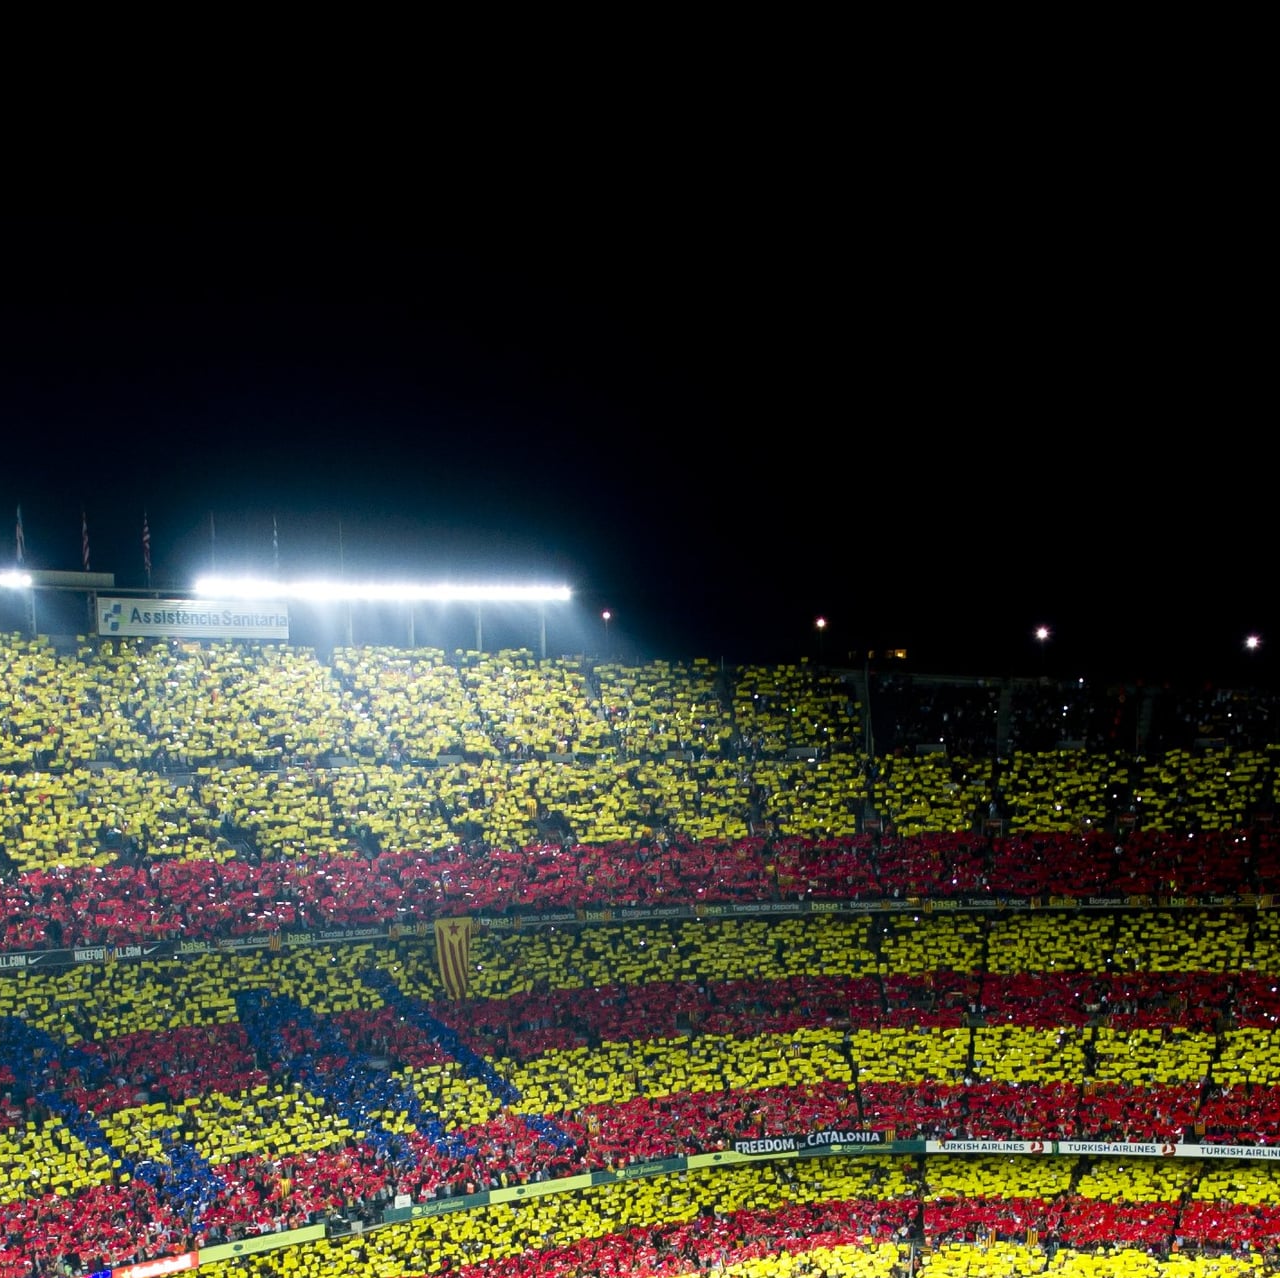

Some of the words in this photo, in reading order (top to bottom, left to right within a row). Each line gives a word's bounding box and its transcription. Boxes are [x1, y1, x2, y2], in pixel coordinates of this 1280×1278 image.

[180, 940, 211, 952] base:
[734, 1137, 795, 1154] FREEDOM
[806, 1131, 880, 1147] CATALONIA
[981, 1142, 1025, 1152] AIRLINES
[1067, 1143, 1111, 1152] TURKISH
[1113, 1143, 1156, 1153] AIRLINES
[1199, 1146, 1243, 1156] TURKISH
